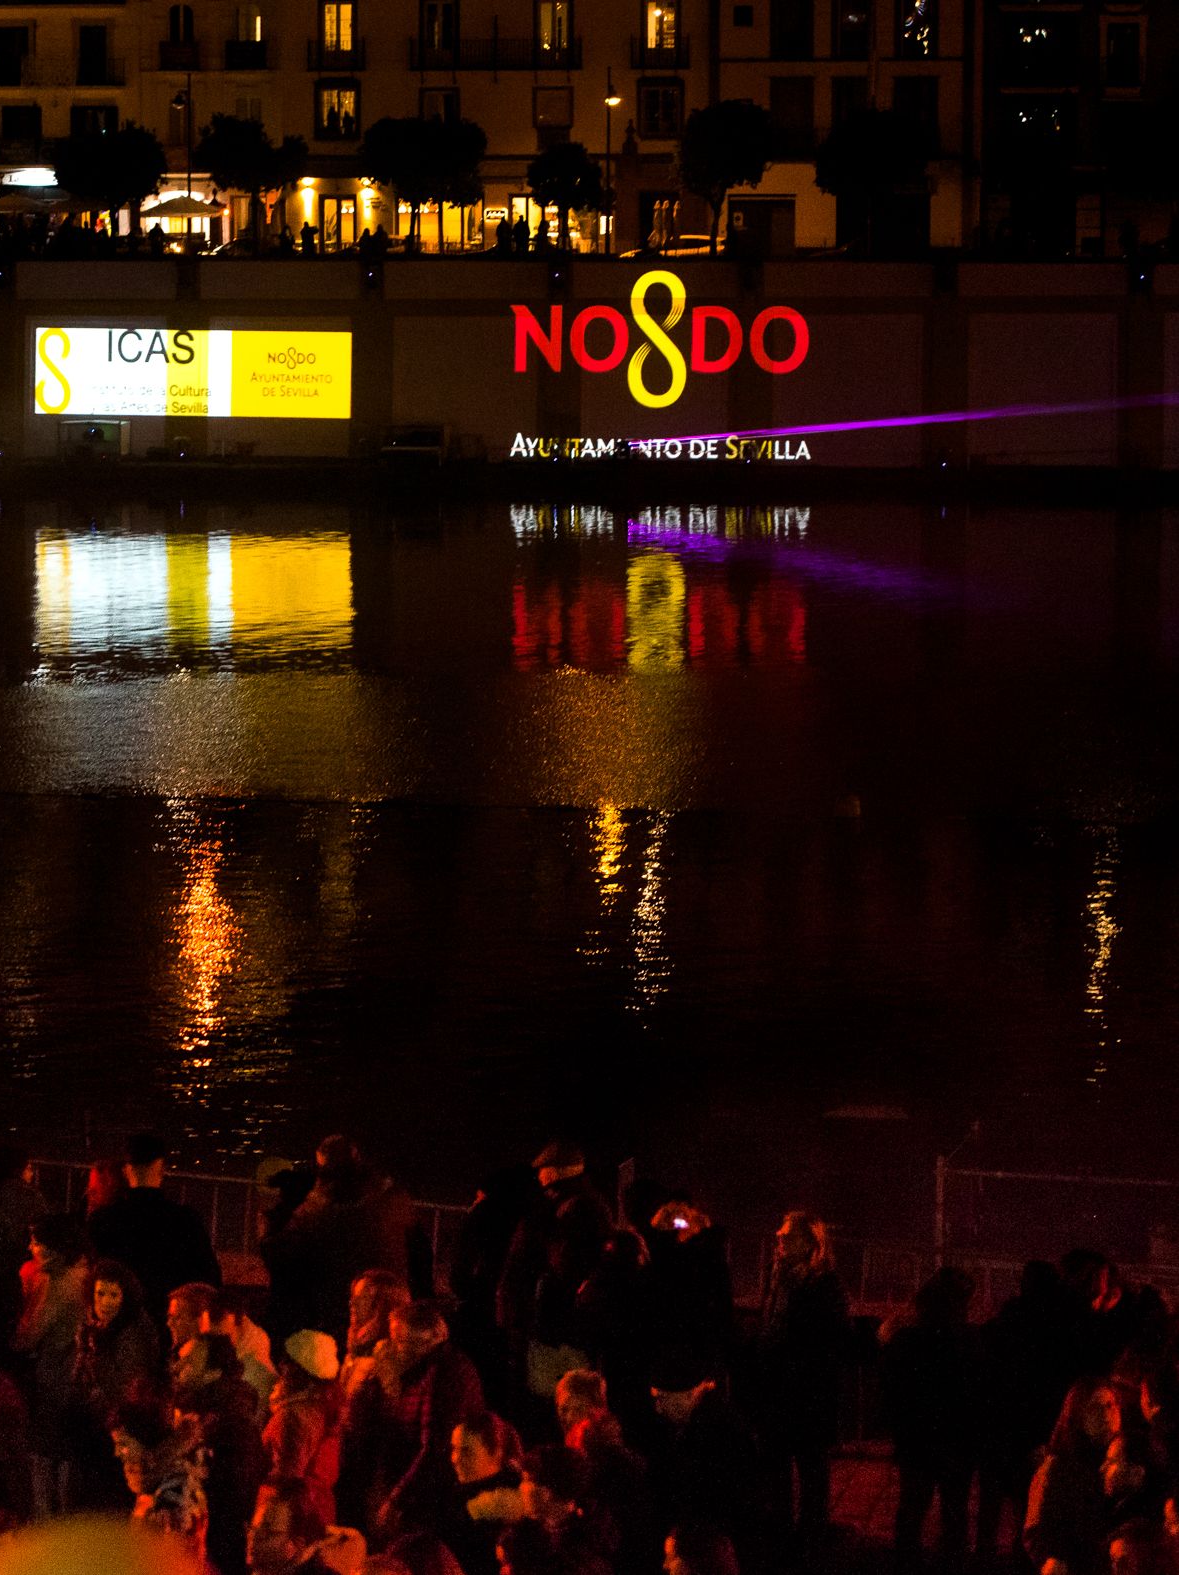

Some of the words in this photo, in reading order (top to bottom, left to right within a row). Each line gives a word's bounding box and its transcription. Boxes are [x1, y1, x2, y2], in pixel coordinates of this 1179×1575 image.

[107, 329, 195, 364] ICAS
[169, 384, 212, 397] Cultura
[171, 401, 209, 414] Sevilla
[690, 440, 719, 460] DE
